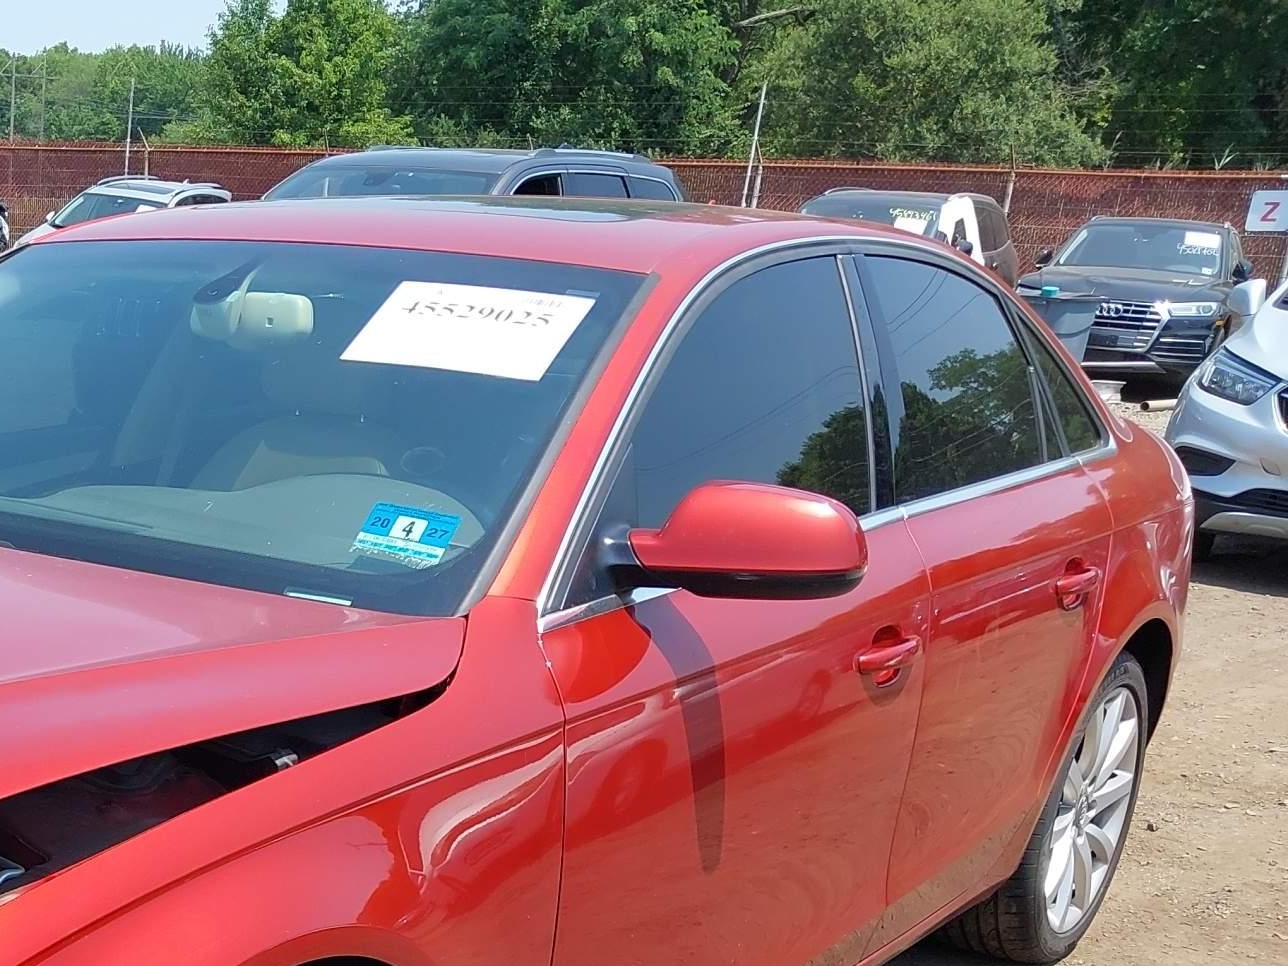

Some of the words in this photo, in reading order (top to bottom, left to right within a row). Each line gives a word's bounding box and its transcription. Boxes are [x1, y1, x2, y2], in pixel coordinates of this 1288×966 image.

[1259, 202, 1281, 222] Z
[401, 300, 555, 327] 45529025
[370, 516, 392, 530] 20
[402, 521, 416, 537] 4
[427, 527, 450, 540] 27
